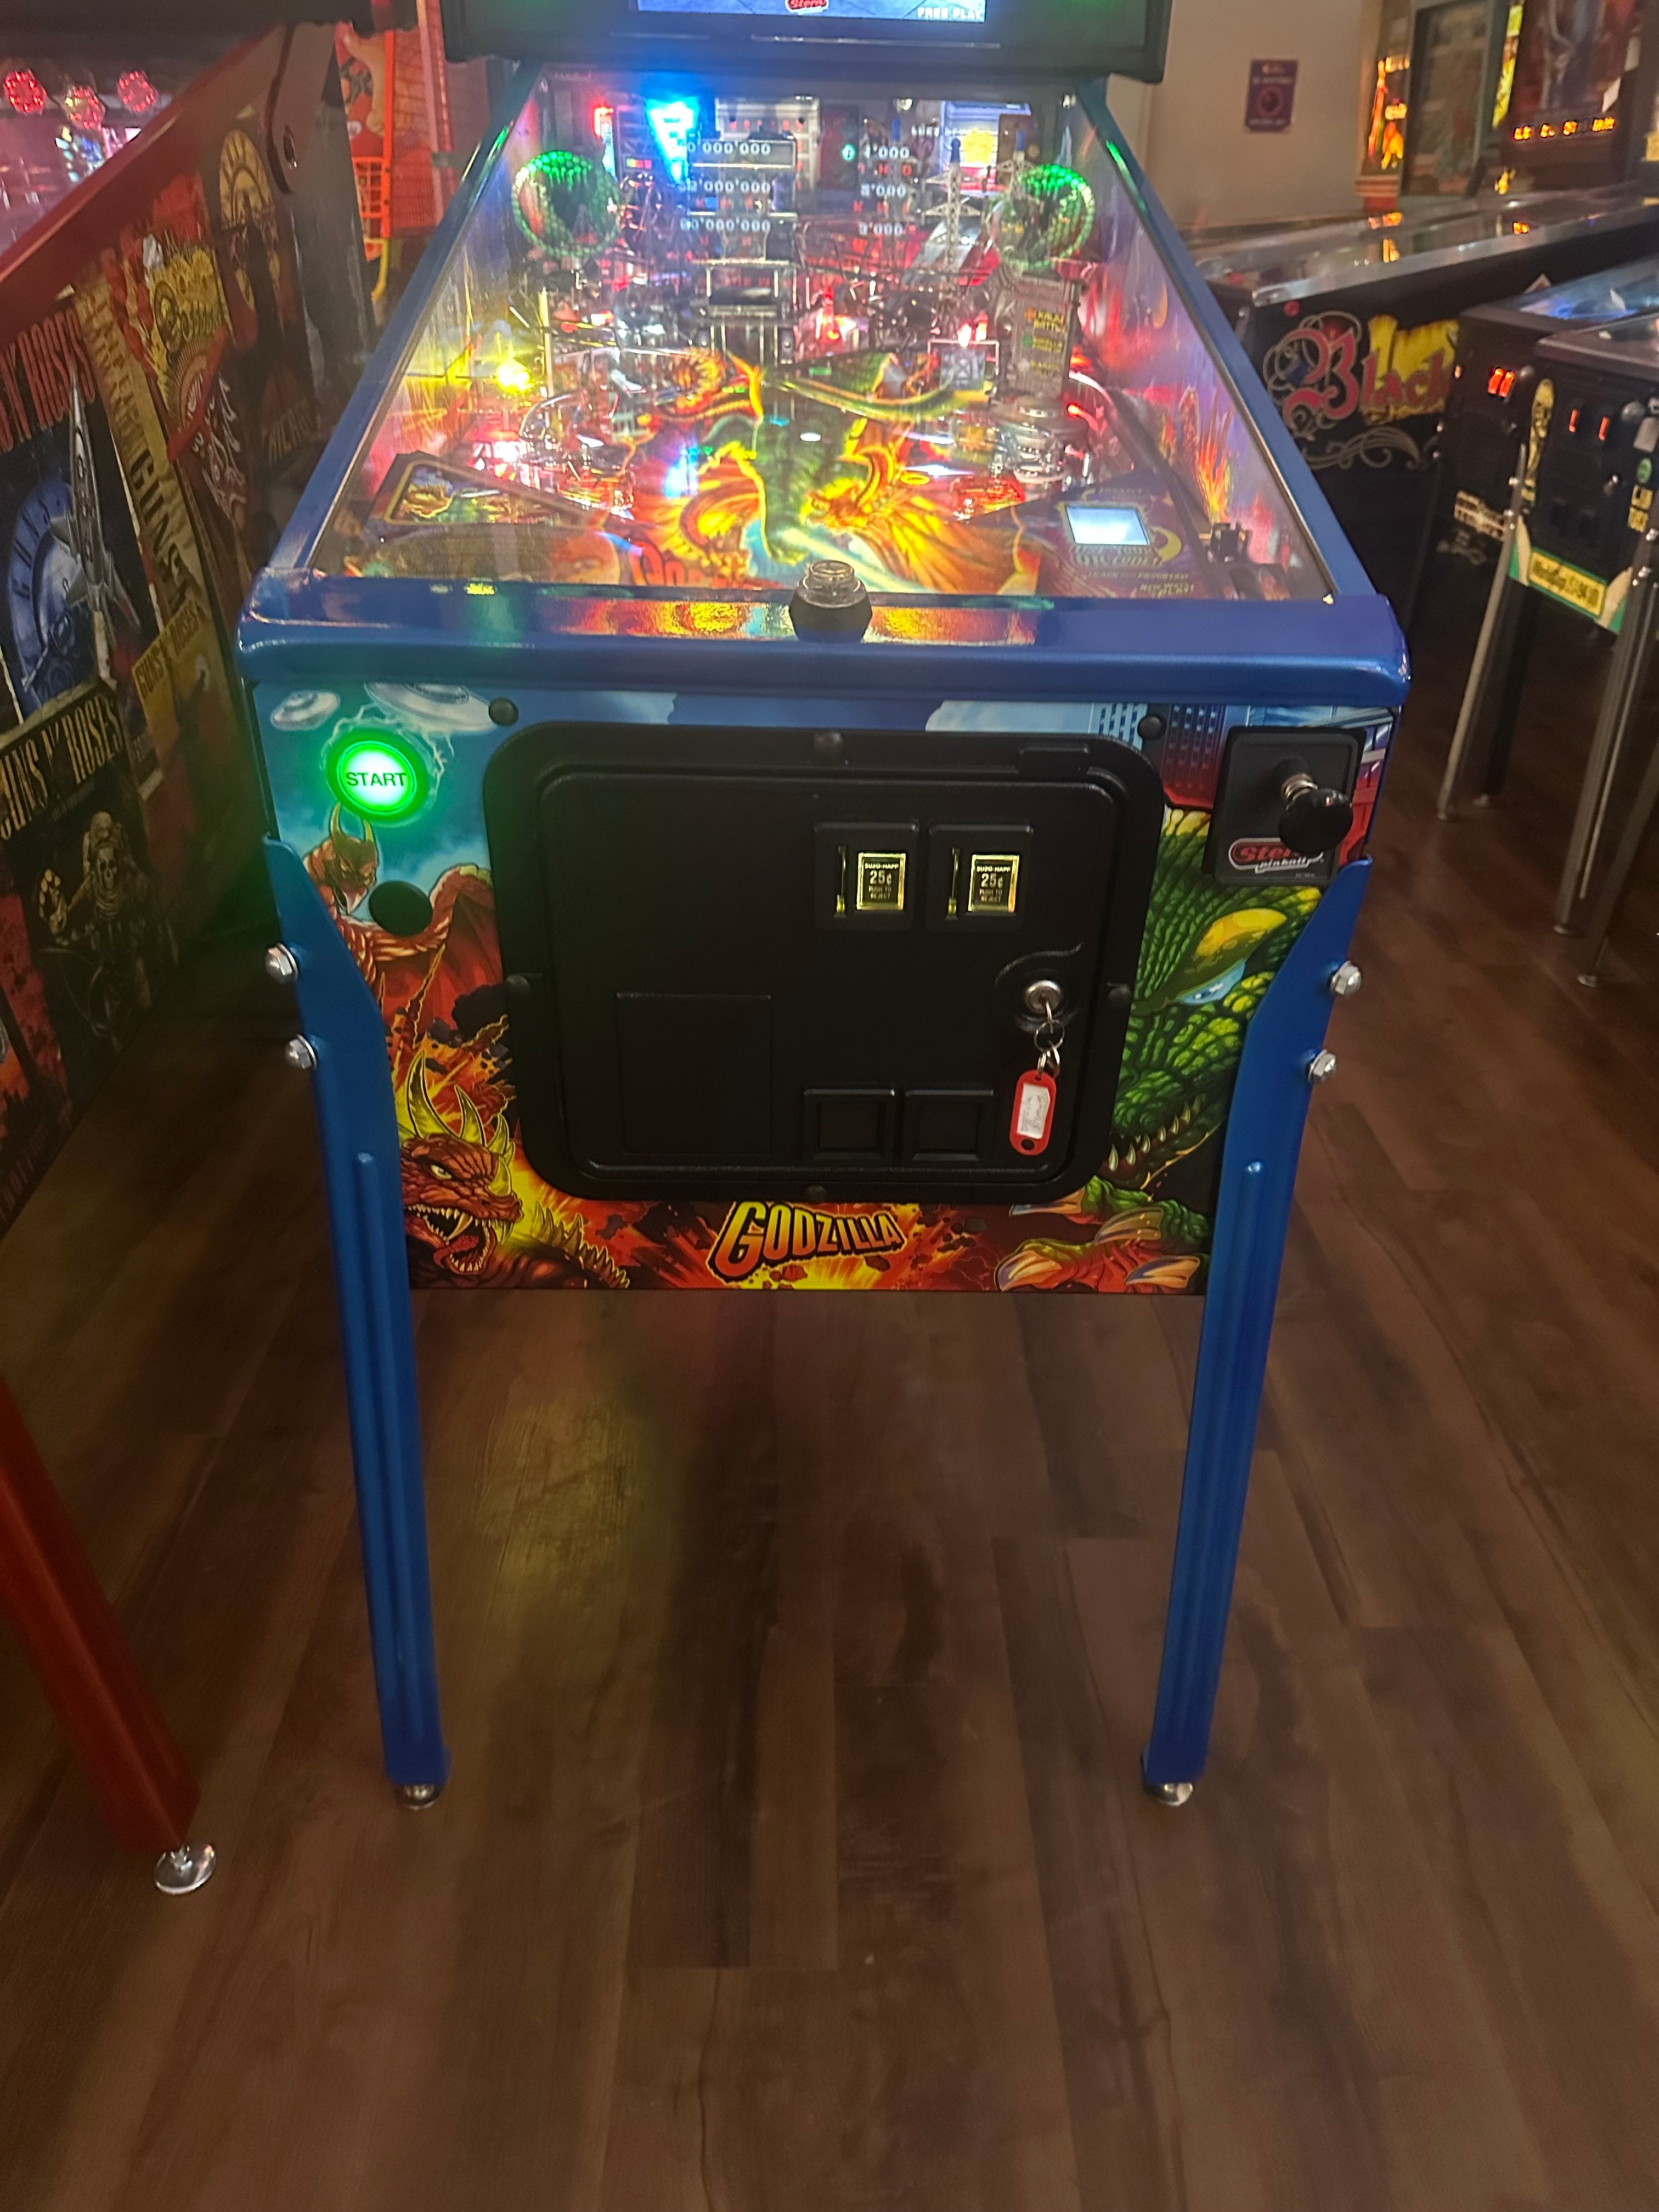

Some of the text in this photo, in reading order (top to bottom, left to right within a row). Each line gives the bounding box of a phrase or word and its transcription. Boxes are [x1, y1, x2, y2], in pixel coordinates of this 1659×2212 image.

[917, 7, 984, 20] FREE PLAY
[61, 693, 124, 784] ROSES
[346, 772, 407, 787] START
[1259, 856, 1307, 870] pinball
[713, 1201, 904, 1279] GODZILLA
